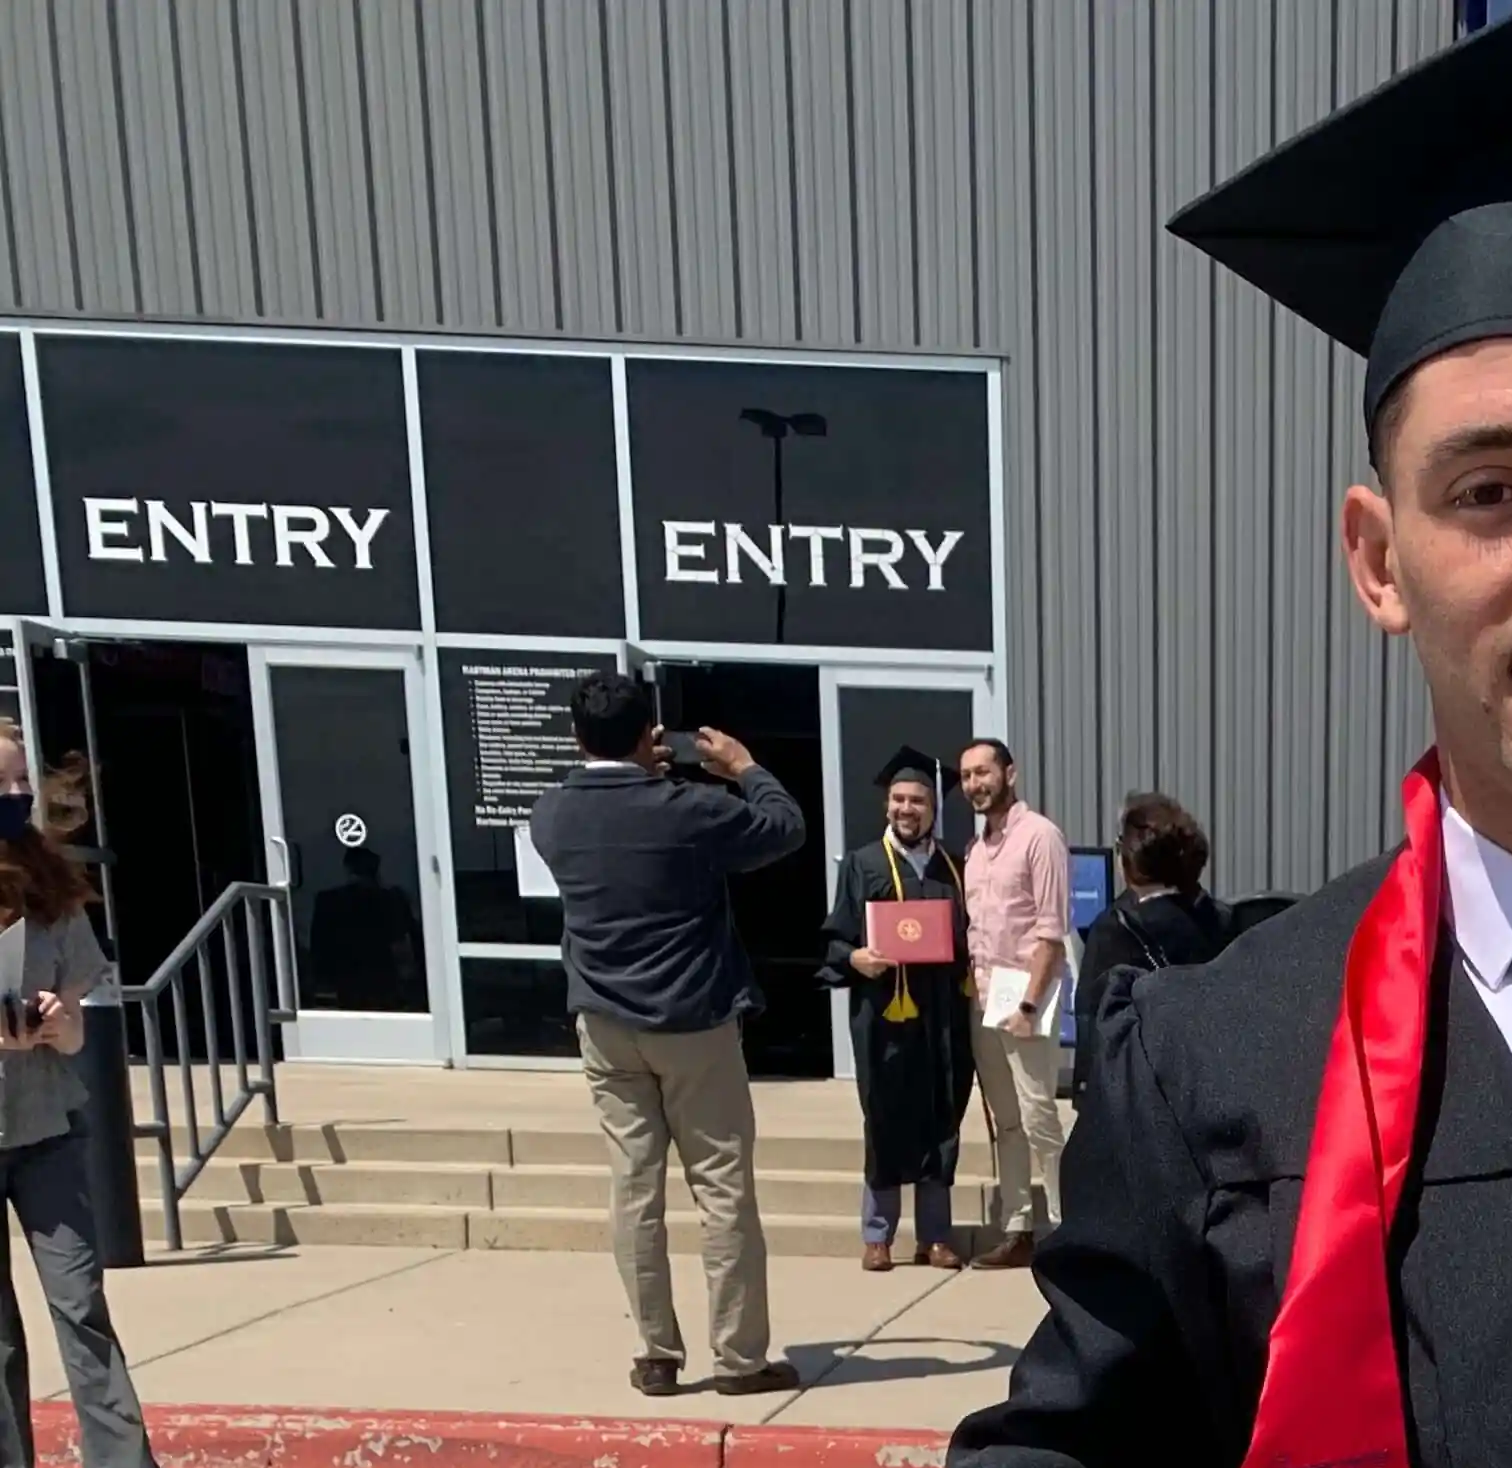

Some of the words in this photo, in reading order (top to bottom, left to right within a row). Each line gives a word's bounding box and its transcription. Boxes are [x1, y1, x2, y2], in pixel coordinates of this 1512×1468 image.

[82, 496, 391, 569] ENTRY
[662, 520, 965, 590] ENTRY
[462, 665, 502, 676] HARTMAN
[502, 666, 529, 677] ARENA
